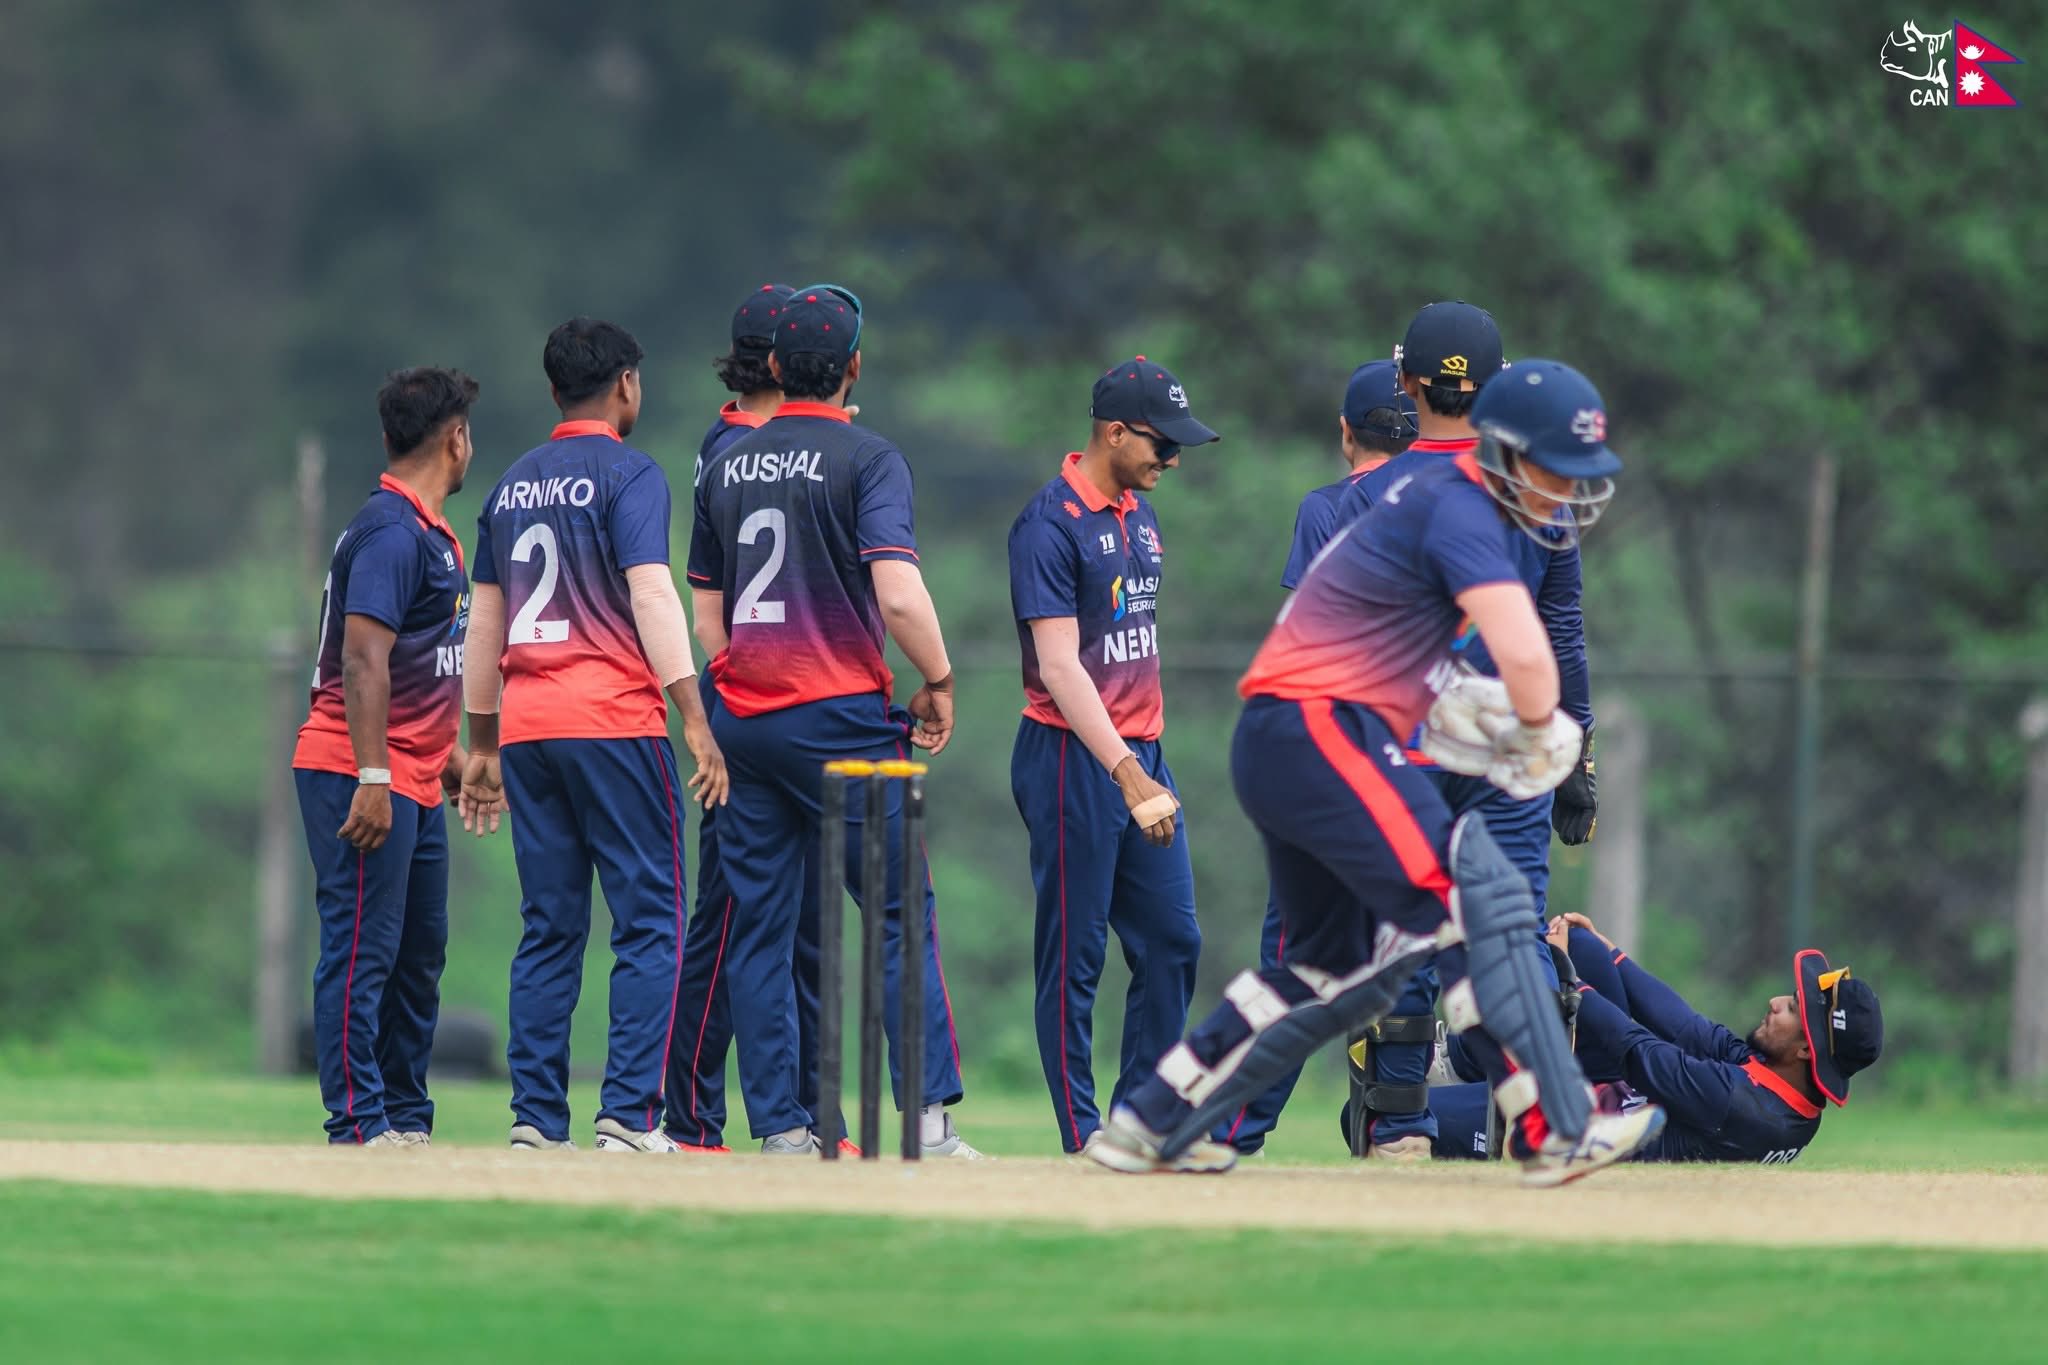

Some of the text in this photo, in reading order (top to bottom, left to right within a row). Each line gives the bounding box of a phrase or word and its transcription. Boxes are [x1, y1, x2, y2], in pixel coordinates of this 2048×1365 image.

[495, 477, 595, 515] ARNIKO
[723, 449, 824, 488] KUSHAL
[508, 523, 570, 645] 2
[737, 507, 786, 625] 2
